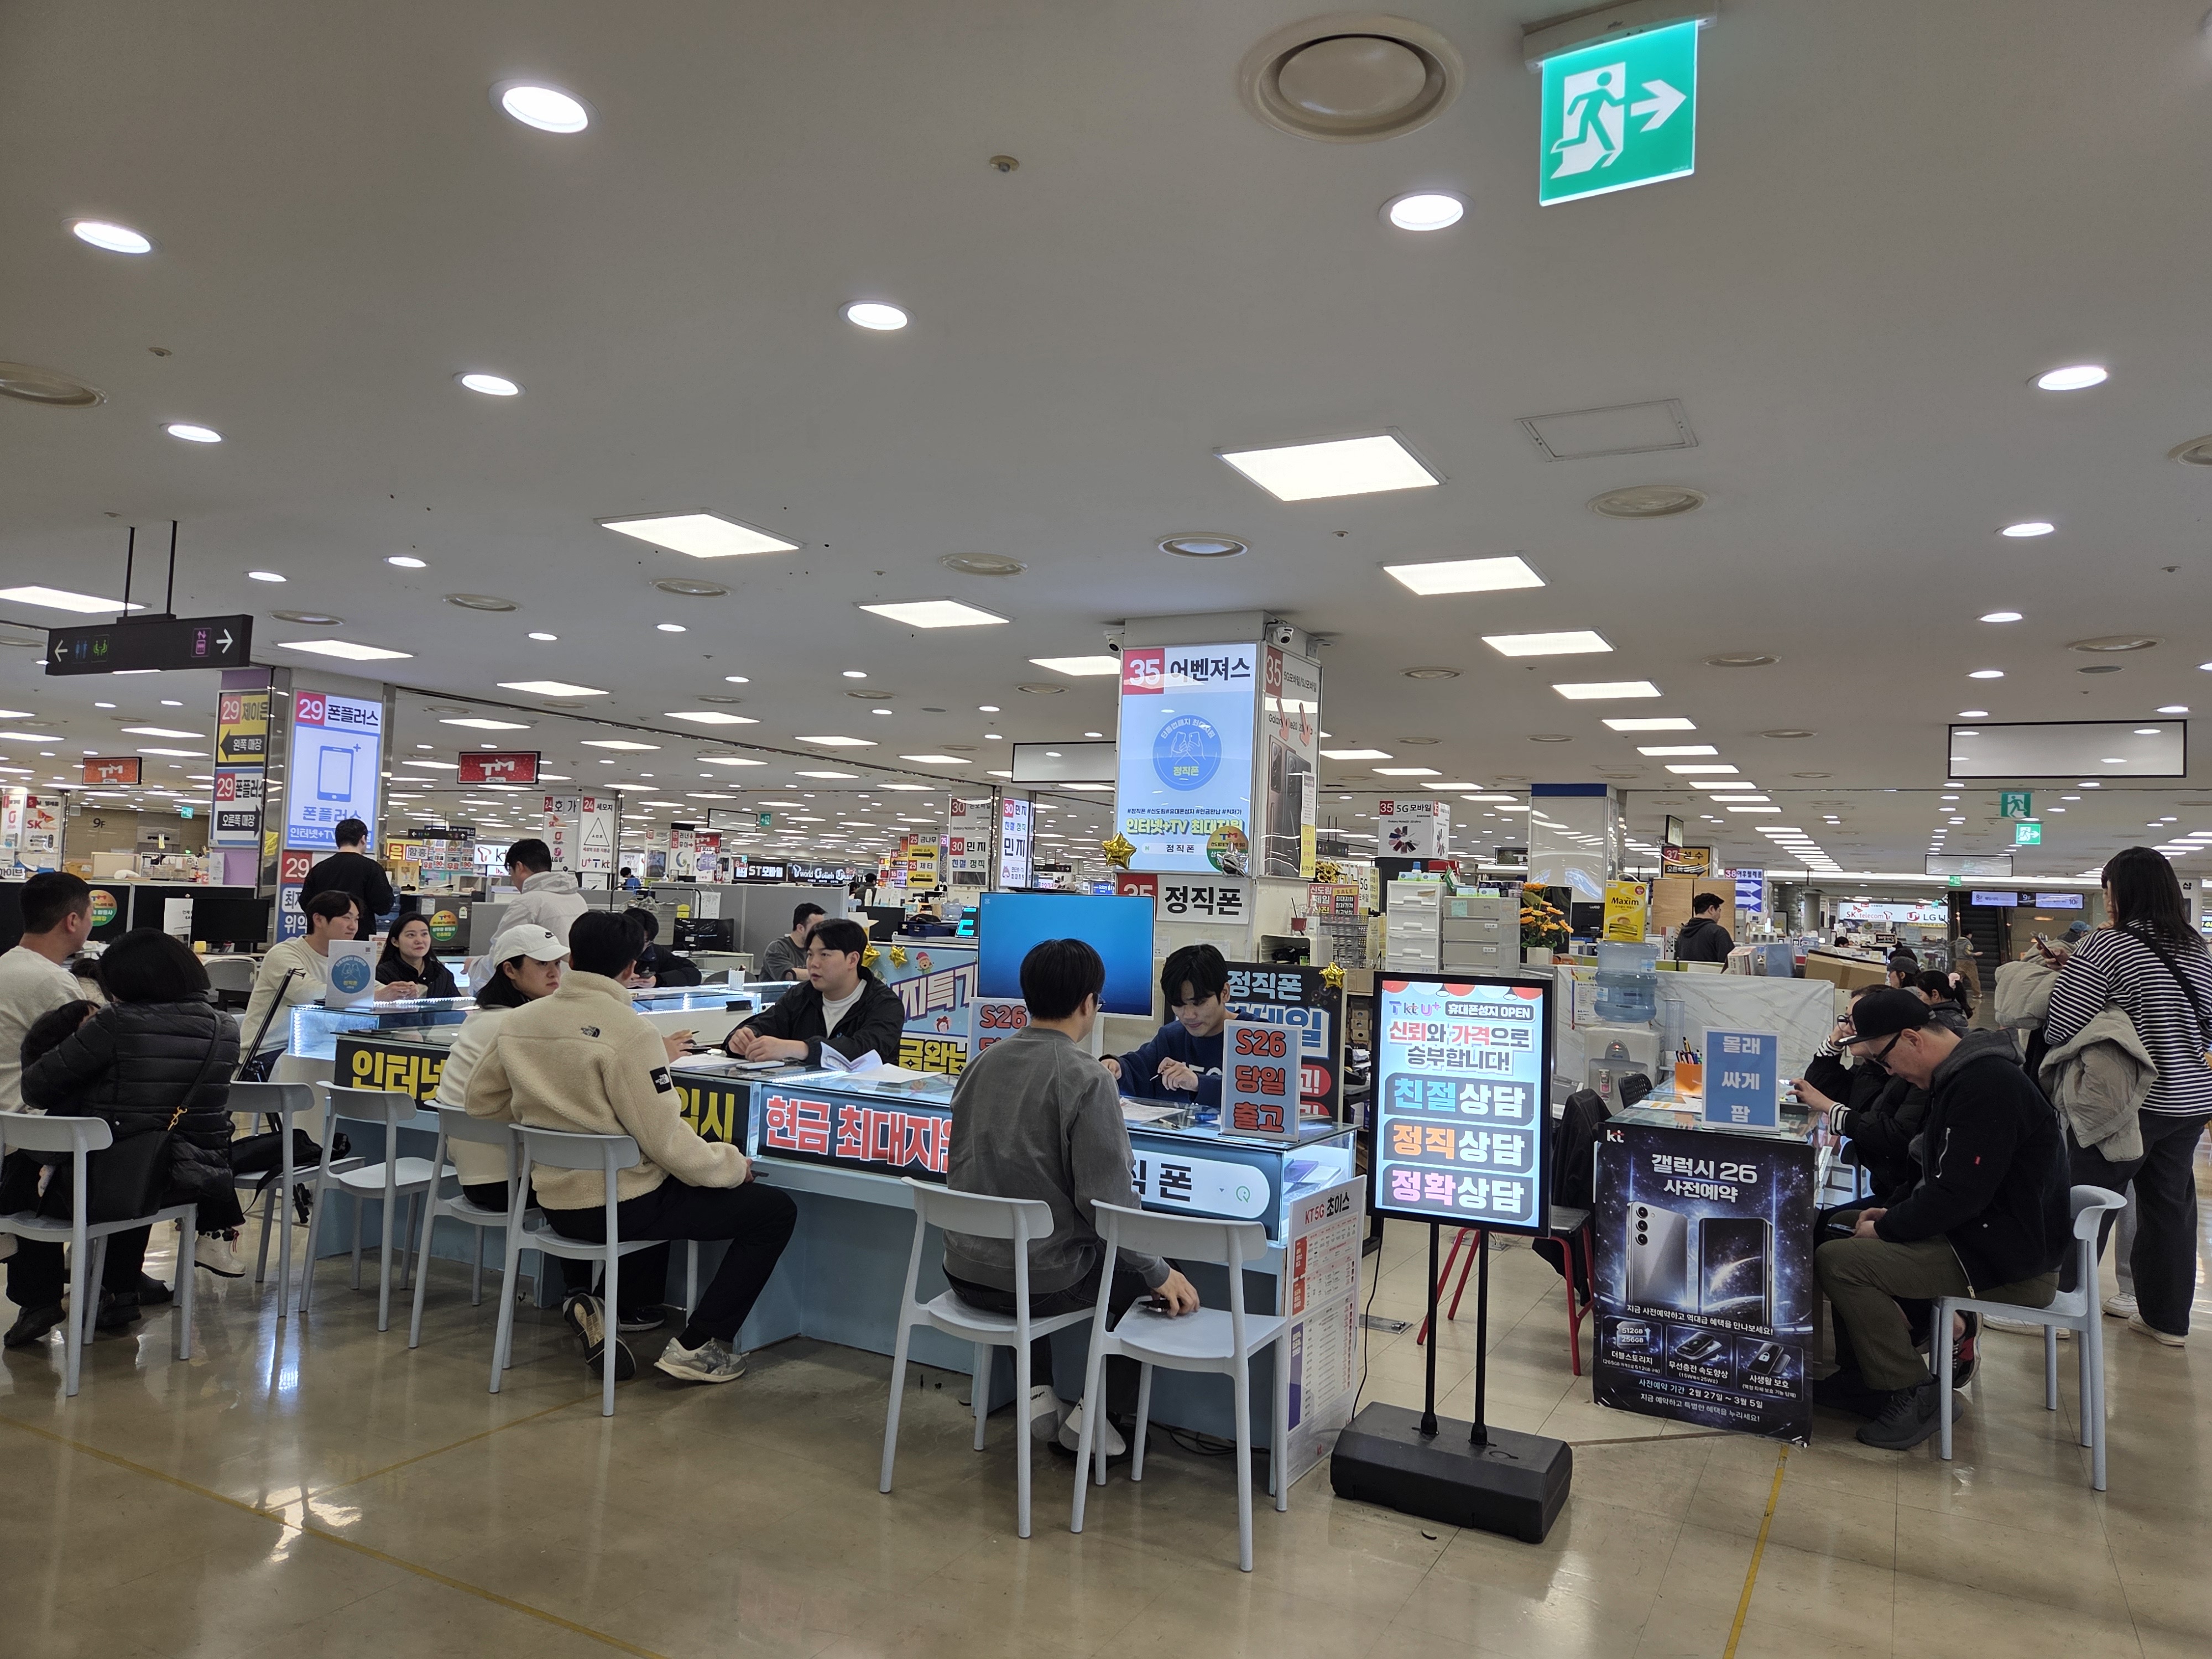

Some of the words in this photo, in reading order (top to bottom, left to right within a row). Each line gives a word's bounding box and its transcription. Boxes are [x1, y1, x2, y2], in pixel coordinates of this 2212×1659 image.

[1130, 659, 1160, 685] 35
[1171, 657, 1250, 682] 어벤져스
[1266, 655, 1281, 687] 35
[222, 700, 239, 720] 29
[299, 699, 324, 720] 29
[328, 704, 378, 726] 폰플러스
[233, 739, 247, 751] 왼쪽
[248, 739, 262, 751] 매장
[1173, 766, 1199, 776] 정직폰
[216, 778, 233, 801] 29
[584, 801, 593, 810] 24
[952, 802, 965, 813] 30
[1005, 804, 1013, 813] 30
[1015, 805, 1026, 816] 민지
[1380, 803, 1393, 812] 35
[27, 820, 43, 829] SK
[93, 818, 106, 828] 9F
[222, 815, 240, 827] 오른쪽
[242, 816, 255, 827] 매장
[1126, 818, 1190, 834] 인터넷+TV
[952, 842, 963, 851] 30
[967, 842, 985, 852] 민지
[1004, 838, 1025, 857] 민지
[1166, 844, 1195, 853] 정직폰
[1667, 850, 1678, 859] 37
[285, 858, 309, 878] 29
[593, 859, 600, 868] T
[602, 860, 610, 868] kt
[749, 865, 783, 878] ST모바일
[952, 859, 966, 868] 친절
[970, 860, 985, 868] 정직
[1360, 878, 1368, 890] 5G
[1165, 885, 1243, 916] 정직폰
[1611, 896, 1639, 906] Maxim
[892, 964, 978, 1019] 지특가
[1227, 971, 1302, 1000] 정직폰
[979, 1004, 1027, 1029] S26
[1389, 1001, 1402, 1015] T
[1404, 1001, 1418, 1015] kt
[1448, 1004, 1498, 1017] 휴대폰성지
[1501, 1007, 1530, 1019] OPEN
[1235, 1028, 1286, 1057] S26
[1390, 1021, 1446, 1042] 신뢰와
[1452, 1025, 1530, 1048] 가격으로
[1723, 1035, 1761, 1055] 몰래
[1407, 1046, 1510, 1071] 승부합니다!
[1235, 1065, 1286, 1095] 당일
[1722, 1071, 1760, 1090] 싸게
[1394, 1078, 1526, 1118] 친절상담
[1233, 1102, 1285, 1133] 출고
[1731, 1105, 1750, 1123] 팜
[766, 1095, 831, 1155] 현금
[837, 1105, 952, 1173] 최대지
[1606, 1130, 1624, 1143] kt
[1393, 1125, 1525, 1166] 정직상담
[1651, 1154, 1714, 1179] 갤럭시
[1719, 1162, 1757, 1183] 26
[1392, 1170, 1524, 1213] 정확상담
[1663, 1180, 1738, 1203] 사전예약
[1327, 1192, 1349, 1218] 초이스
[1627, 1305, 1641, 1314] 지금
[1642, 1307, 1685, 1321] 사전예약하고
[1687, 1314, 1708, 1324] 역대급
[1710, 1318, 1731, 1328] 혜택을
[1733, 1322, 1773, 1335] 만나보세요!
[1611, 1350, 1652, 1365] 더블스토리지
[1668, 1361, 1697, 1373] 무선충전
[1750, 1375, 1772, 1386] 사생활
[1774, 1380, 1790, 1389] 보호
[1639, 1378, 1668, 1392] 사전예약
[1670, 1384, 1685, 1394] 기간
[1689, 1388, 1702, 1397] 2월
[1704, 1391, 1723, 1401] 27일
[1734, 1396, 1747, 1407] 3월
[1749, 1399, 1763, 1408] 5일
[1641, 1394, 1653, 1403] 지금
[1655, 1397, 1682, 1407] 예약하고
[1729, 1410, 1760, 1422] 누리세요!
